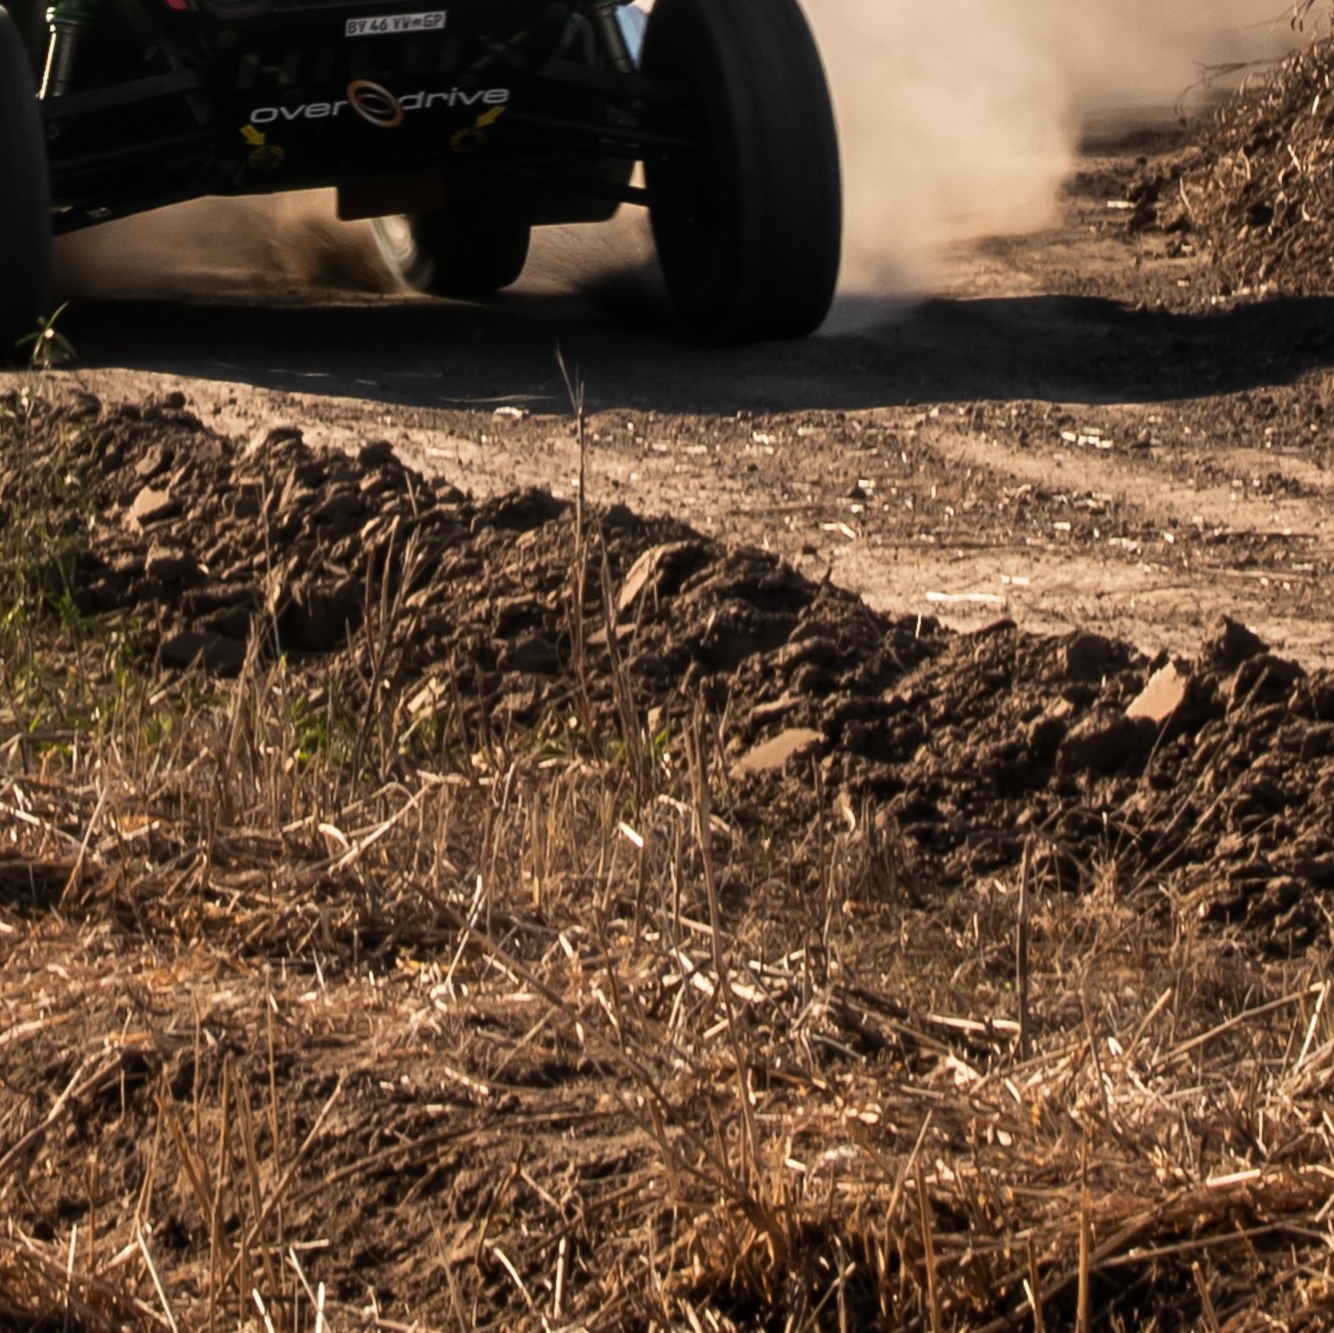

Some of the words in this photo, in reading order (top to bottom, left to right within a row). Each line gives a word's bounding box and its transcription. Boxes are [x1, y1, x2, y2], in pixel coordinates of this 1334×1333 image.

[369, 18, 388, 32] 46
[250, 100, 350, 124] over
[398, 87, 510, 111] drive
